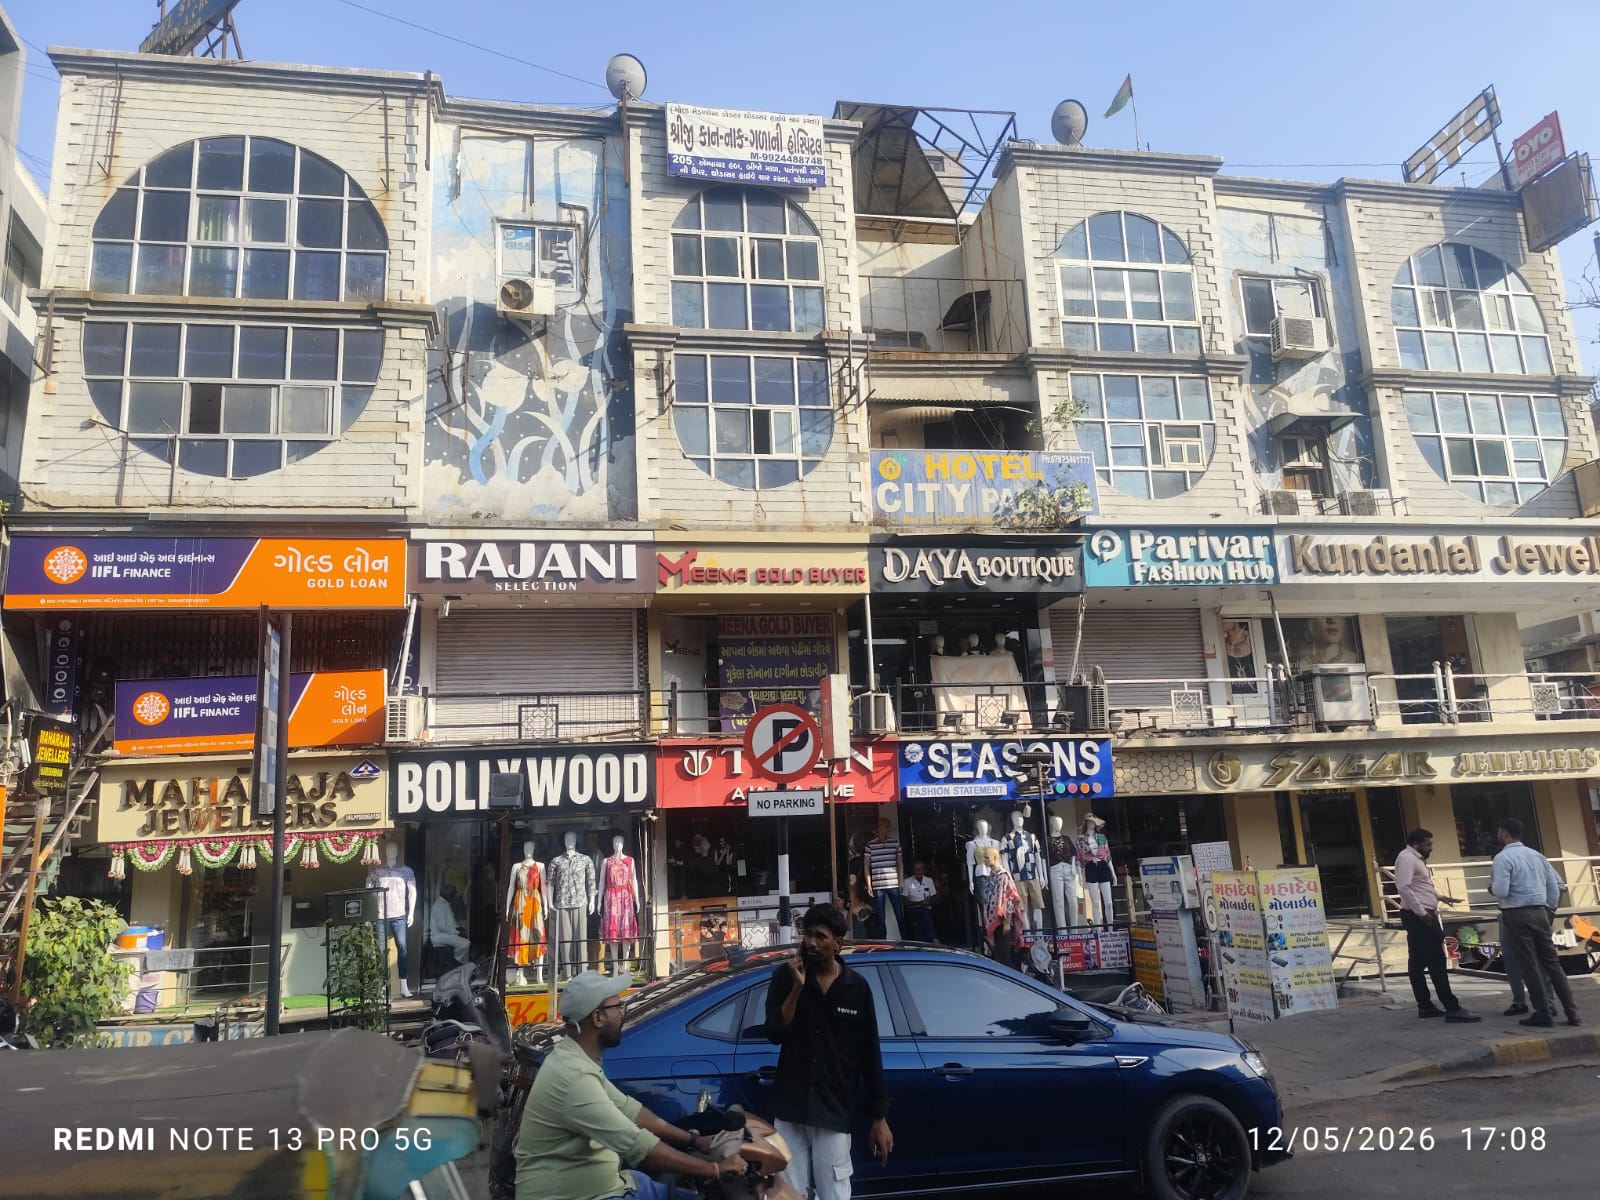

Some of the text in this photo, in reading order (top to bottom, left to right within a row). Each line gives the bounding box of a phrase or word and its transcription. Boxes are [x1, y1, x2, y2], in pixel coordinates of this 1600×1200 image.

[671, 114, 694, 152] શ્રીજી
[787, 127, 823, 156] હોસ્પિટલ
[1517, 126, 1554, 161] OYO
[751, 152, 823, 165] M-9924488748
[925, 453, 1044, 480] HOTEL
[876, 482, 971, 513] CITY
[1129, 529, 1271, 560] Parivar
[1289, 534, 1482, 574] Kundanlal
[274, 546, 389, 573] ગોલ્ડ લોન
[424, 542, 638, 580] RAJANI
[657, 549, 866, 587] MEENA GOLD BUYER
[883, 548, 1076, 586] DAYA BOUTIQUE
[92, 565, 171, 578] IIFL FINANCE
[307, 578, 388, 588] GOLD LOAN
[495, 581, 578, 592] SELECTION
[760, 615, 791, 636] GOLD
[333, 685, 367, 701] ગોલ્ડ
[173, 706, 240, 719] IIFL FINANCE
[341, 700, 367, 716] લોન
[40, 729, 70, 749] MAHARAJA
[37, 746, 70, 764] JEWELLERS
[1458, 748, 1599, 775] JEWELLERS
[123, 771, 357, 808] MAHAAJA
[397, 754, 648, 814] BOLLWOOD
[909, 784, 1005, 797] FASHION STATEMENT
[756, 798, 816, 810] NO PARKING
[1215, 878, 1257, 897] મહાદેવ
[1263, 876, 1319, 897] મહાદેવ
[1219, 897, 1256, 911] મોબાઈલ
[1268, 896, 1318, 910] મોબાઈલ
